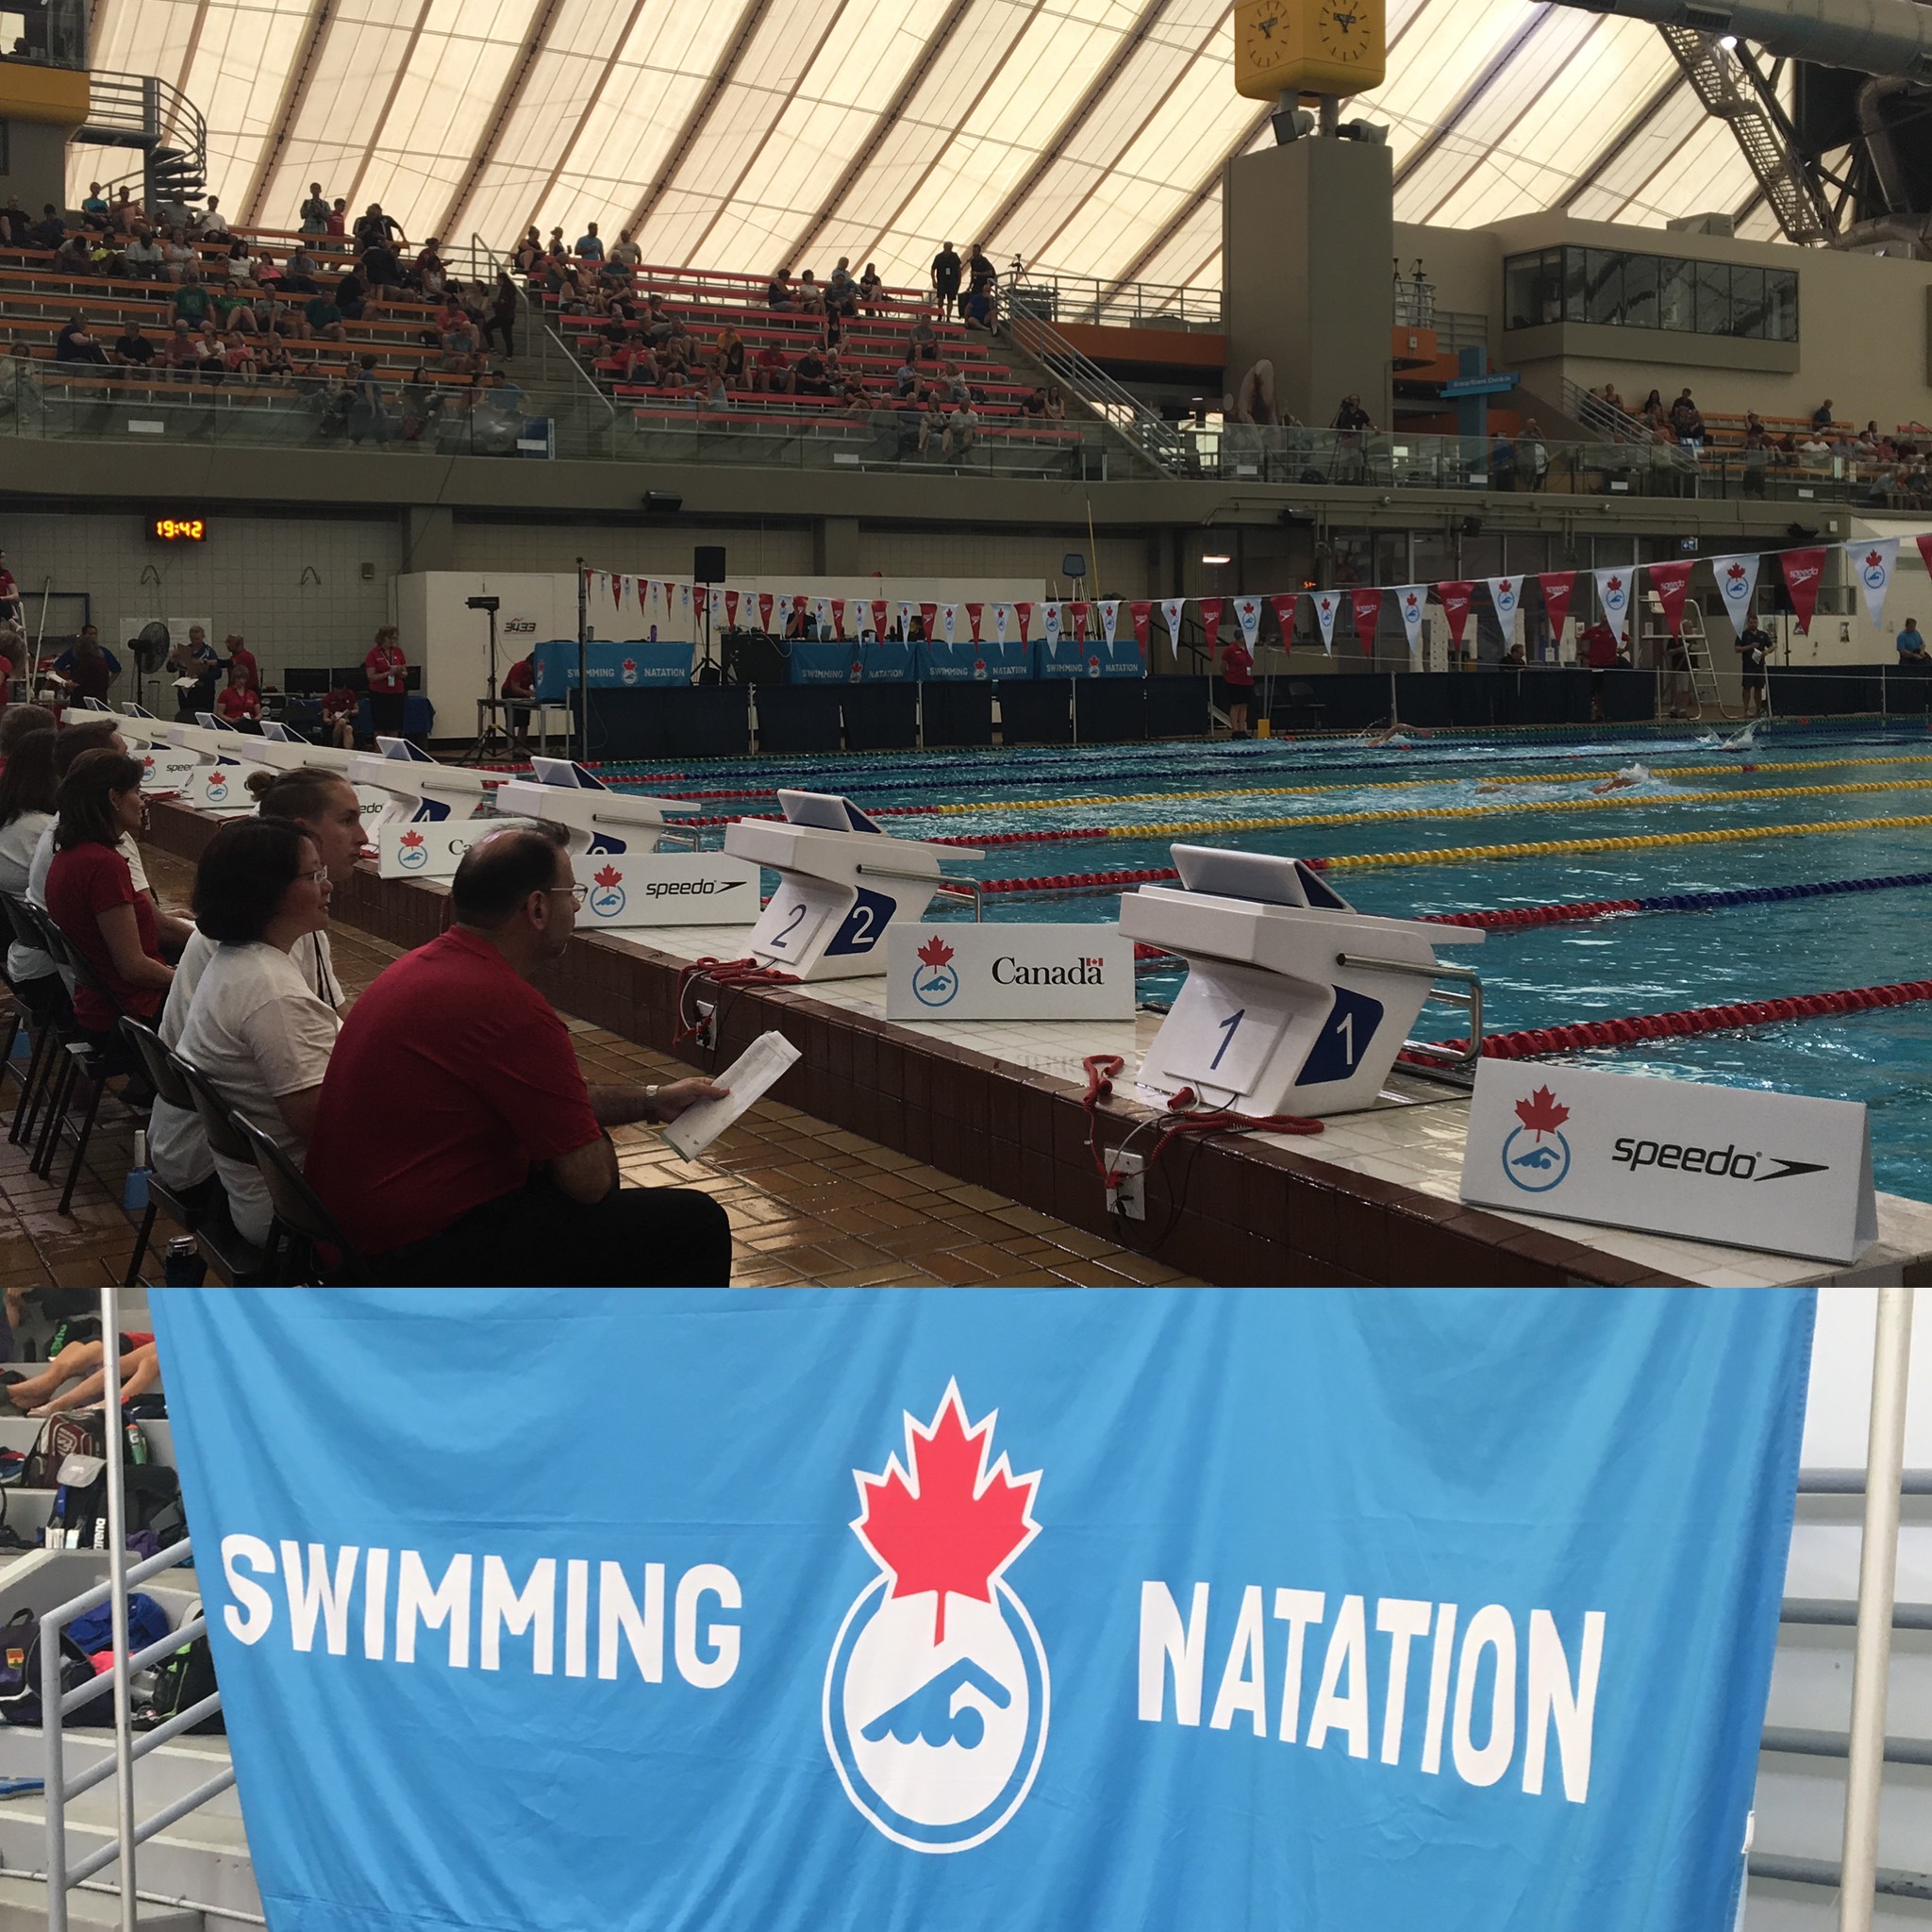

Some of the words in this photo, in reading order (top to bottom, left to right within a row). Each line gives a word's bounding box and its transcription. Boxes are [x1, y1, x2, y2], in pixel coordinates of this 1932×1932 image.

[156, 519, 205, 540] 19:42
[1789, 566, 1819, 580] speedo
[1546, 584, 1570, 593] speedo
[1660, 578, 1686, 591] speedo
[566, 667, 616, 678] SWMMING
[644, 666, 686, 677] NATATION
[801, 668, 844, 679] SWIMMING
[868, 668, 905, 679] NATATION
[929, 666, 968, 676] SWIMMING
[992, 665, 1027, 675] NATATION
[1046, 663, 1083, 674] SWIMMING
[1105, 662, 1139, 673] NATATION
[646, 878, 715, 899] speedo
[770, 904, 808, 949] 2
[851, 905, 875, 944] 2
[991, 956, 1105, 986] Canada
[1209, 1008, 1246, 1071] 1
[1336, 1012, 1354, 1065] 1
[1611, 1137, 1757, 1179] speedo
[93, 1517, 106, 1550] arena
[220, 1533, 742, 1690] SWIMMING
[1138, 1580, 1607, 1804] NATATION
